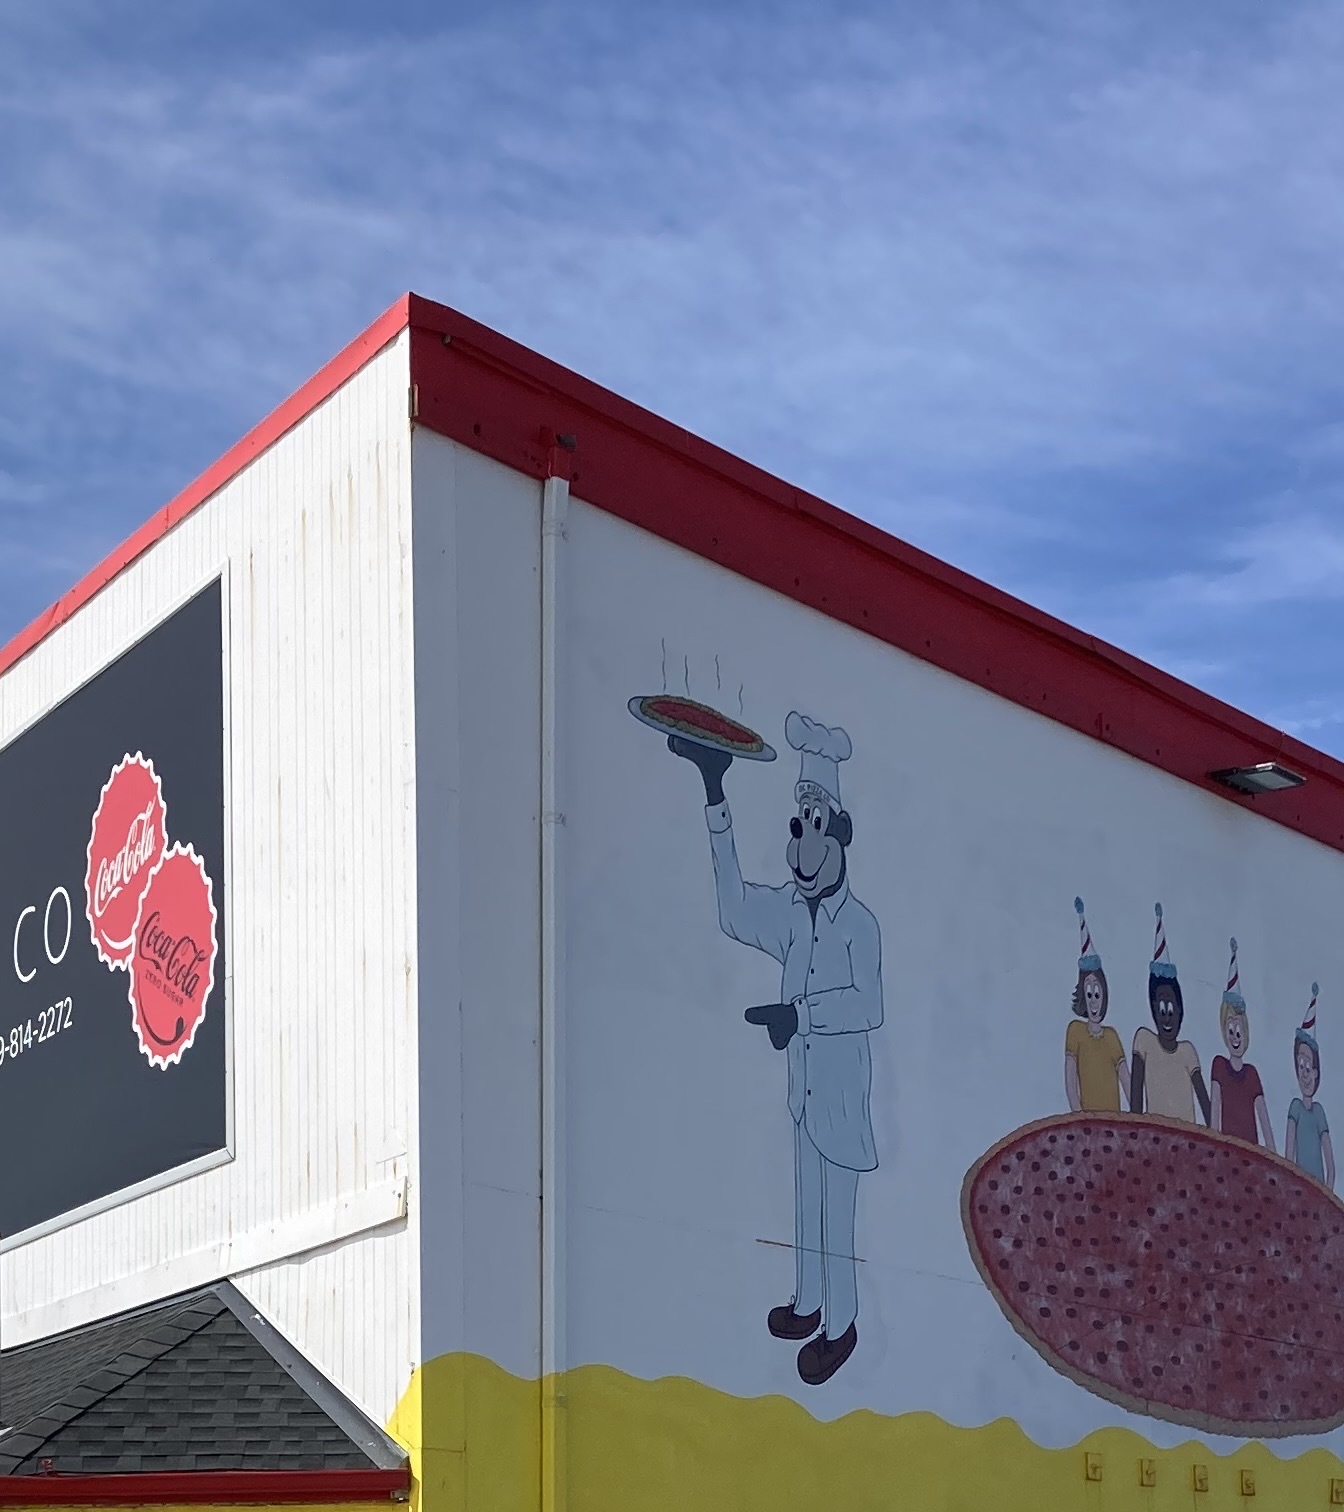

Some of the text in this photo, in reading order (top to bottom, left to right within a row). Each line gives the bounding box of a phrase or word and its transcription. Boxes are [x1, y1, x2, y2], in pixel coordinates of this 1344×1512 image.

[95, 796, 156, 917] Coca-Cola
[14, 886, 72, 982] CO
[140, 911, 207, 999] Coca-Cola
[144, 968, 161, 994] ZERO
